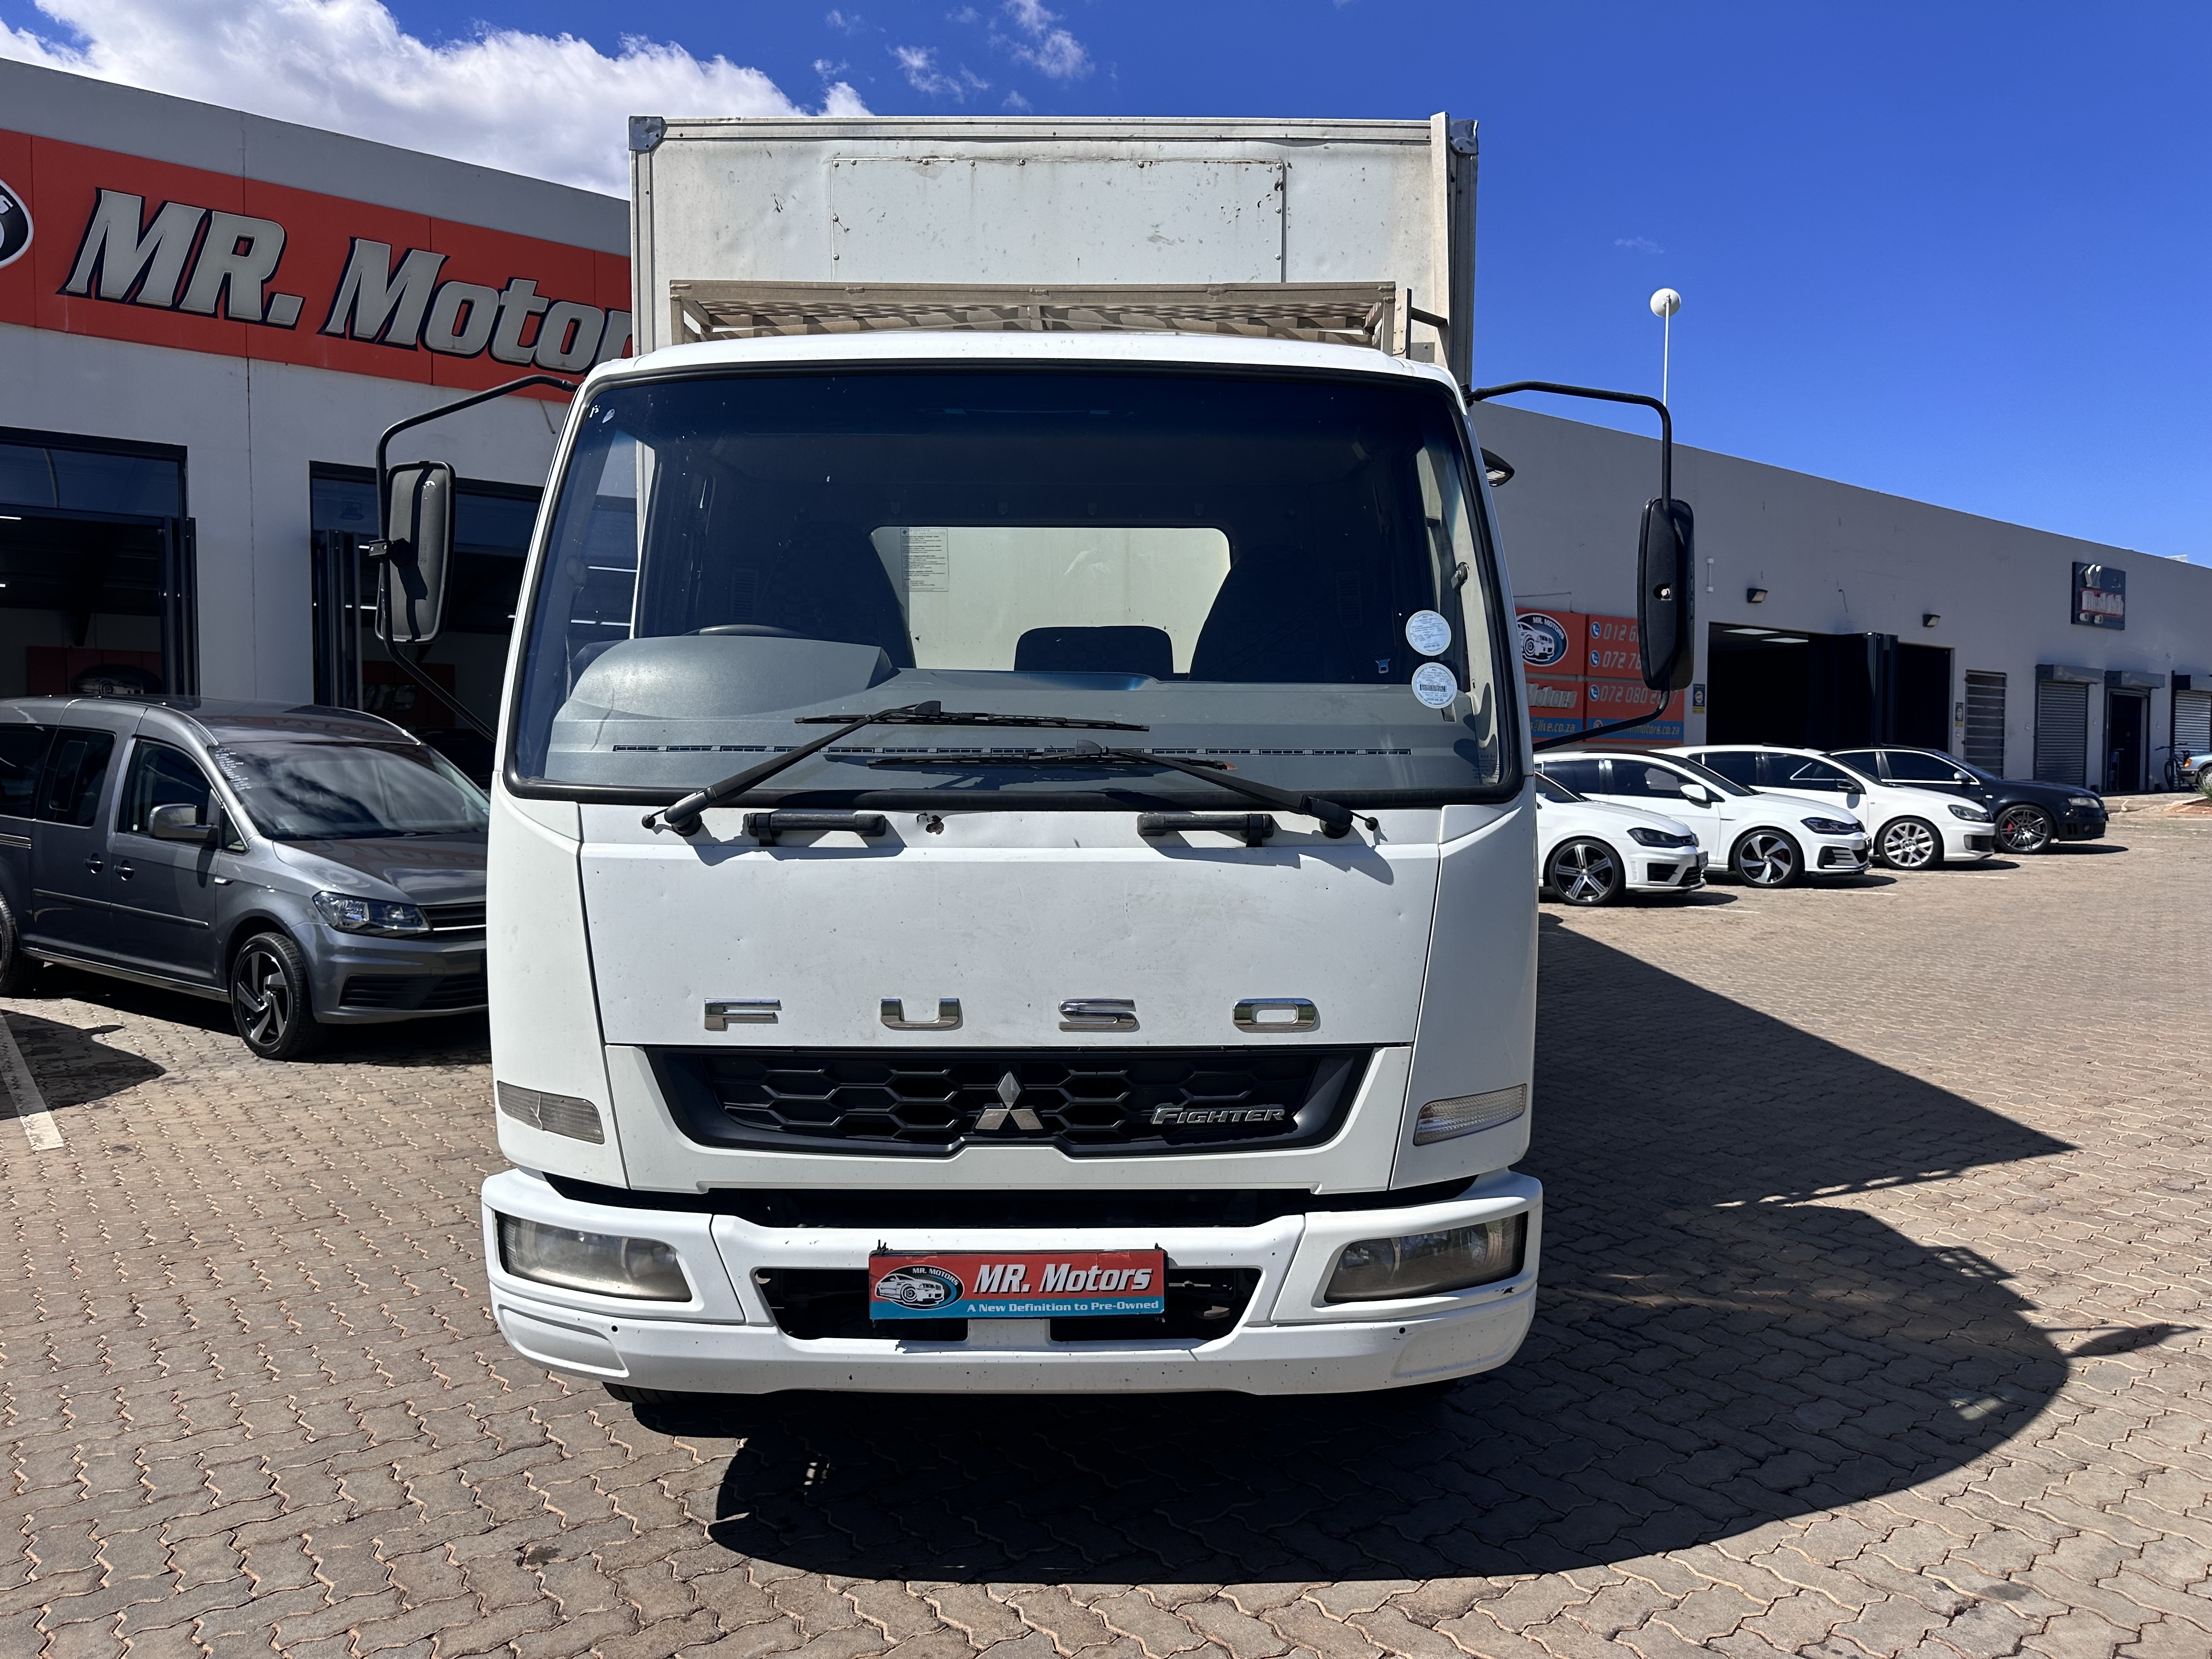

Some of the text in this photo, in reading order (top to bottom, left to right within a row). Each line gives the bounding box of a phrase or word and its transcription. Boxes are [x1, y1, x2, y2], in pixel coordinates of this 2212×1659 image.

[66, 188, 304, 326] MR.
[1544, 618, 1565, 640] MOTORS
[1603, 623, 1640, 642] 012 6
[1602, 651, 1627, 668] 072
[1600, 685, 1623, 703] 072
[1625, 687, 1649, 704] 080
[704, 998, 1316, 1031] FUSO
[1152, 1107, 1285, 1125] FIGHTER
[929, 1268, 959, 1286] MOTORS
[973, 1263, 1152, 1293] MR. Motors
[967, 1300, 1159, 1312] A New Definition to Pre-Owned
